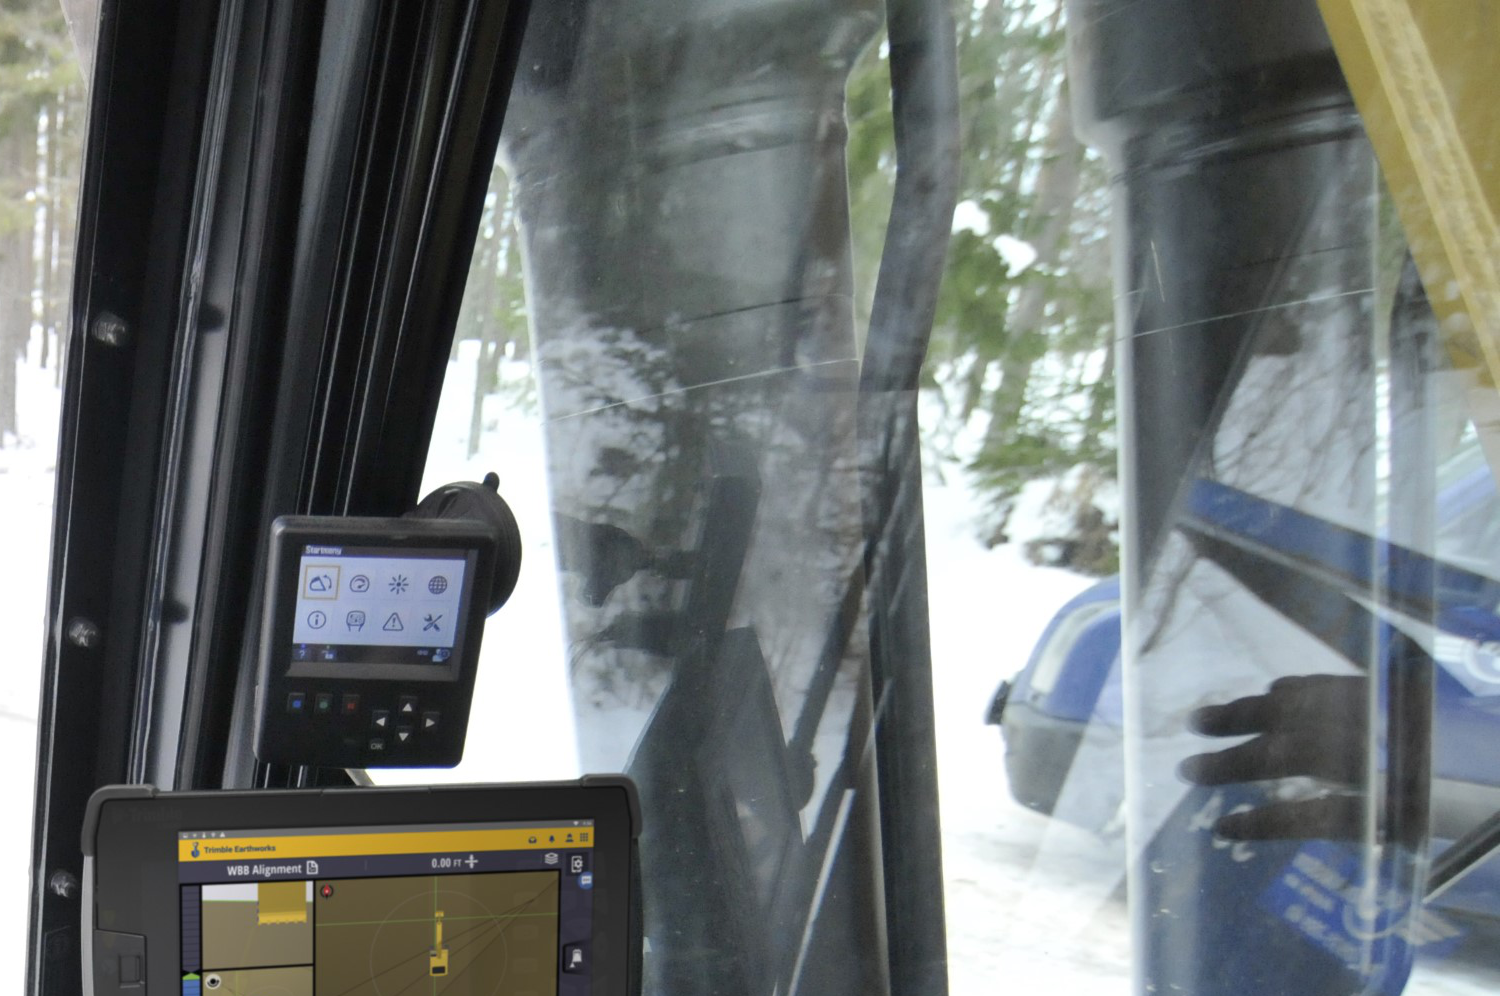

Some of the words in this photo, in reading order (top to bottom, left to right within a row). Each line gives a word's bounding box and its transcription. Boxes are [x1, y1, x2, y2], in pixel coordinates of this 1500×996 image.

[204, 846, 232, 854] Trimble
[234, 845, 276, 853] Earthworks
[431, 857, 451, 868] 0.00
[453, 859, 462, 867] FT
[227, 865, 249, 876] WBB
[252, 864, 302, 877] Alignment
